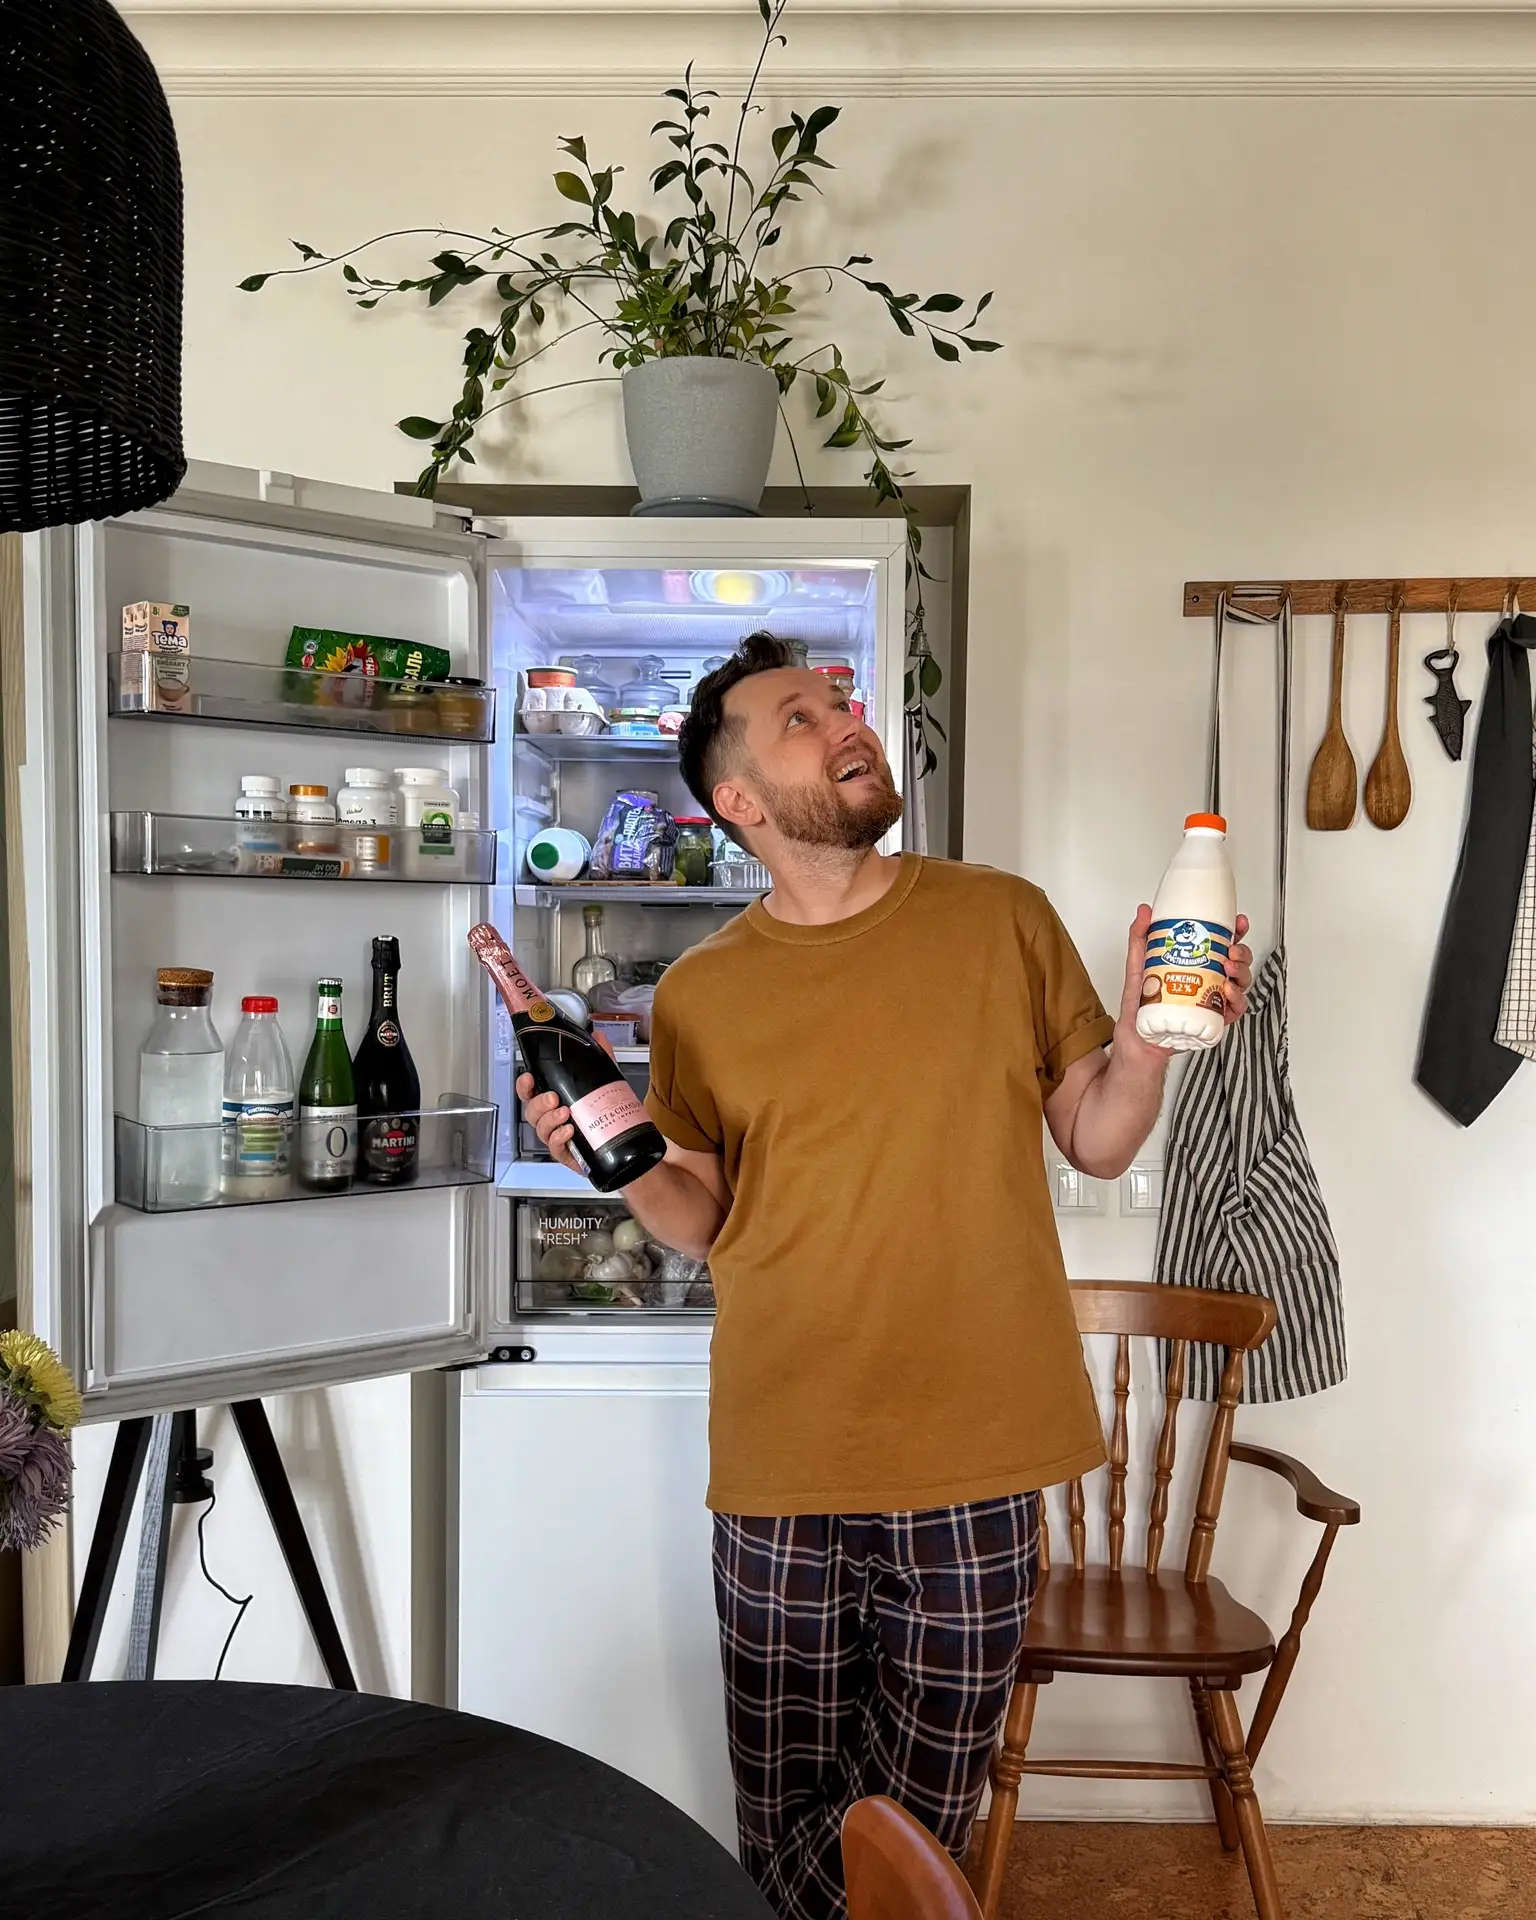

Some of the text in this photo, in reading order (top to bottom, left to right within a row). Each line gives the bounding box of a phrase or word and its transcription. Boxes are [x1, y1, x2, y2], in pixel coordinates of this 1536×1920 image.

[151, 630, 189, 649] Тёма
[400, 650, 423, 693] НСАЛЬ
[1165, 974, 1201, 985] РЯЖЕНКА
[382, 973, 394, 1008] BRUT
[372, 1136, 415, 1148] MARTINI
[539, 1217, 602, 1229] HUMIDITY
